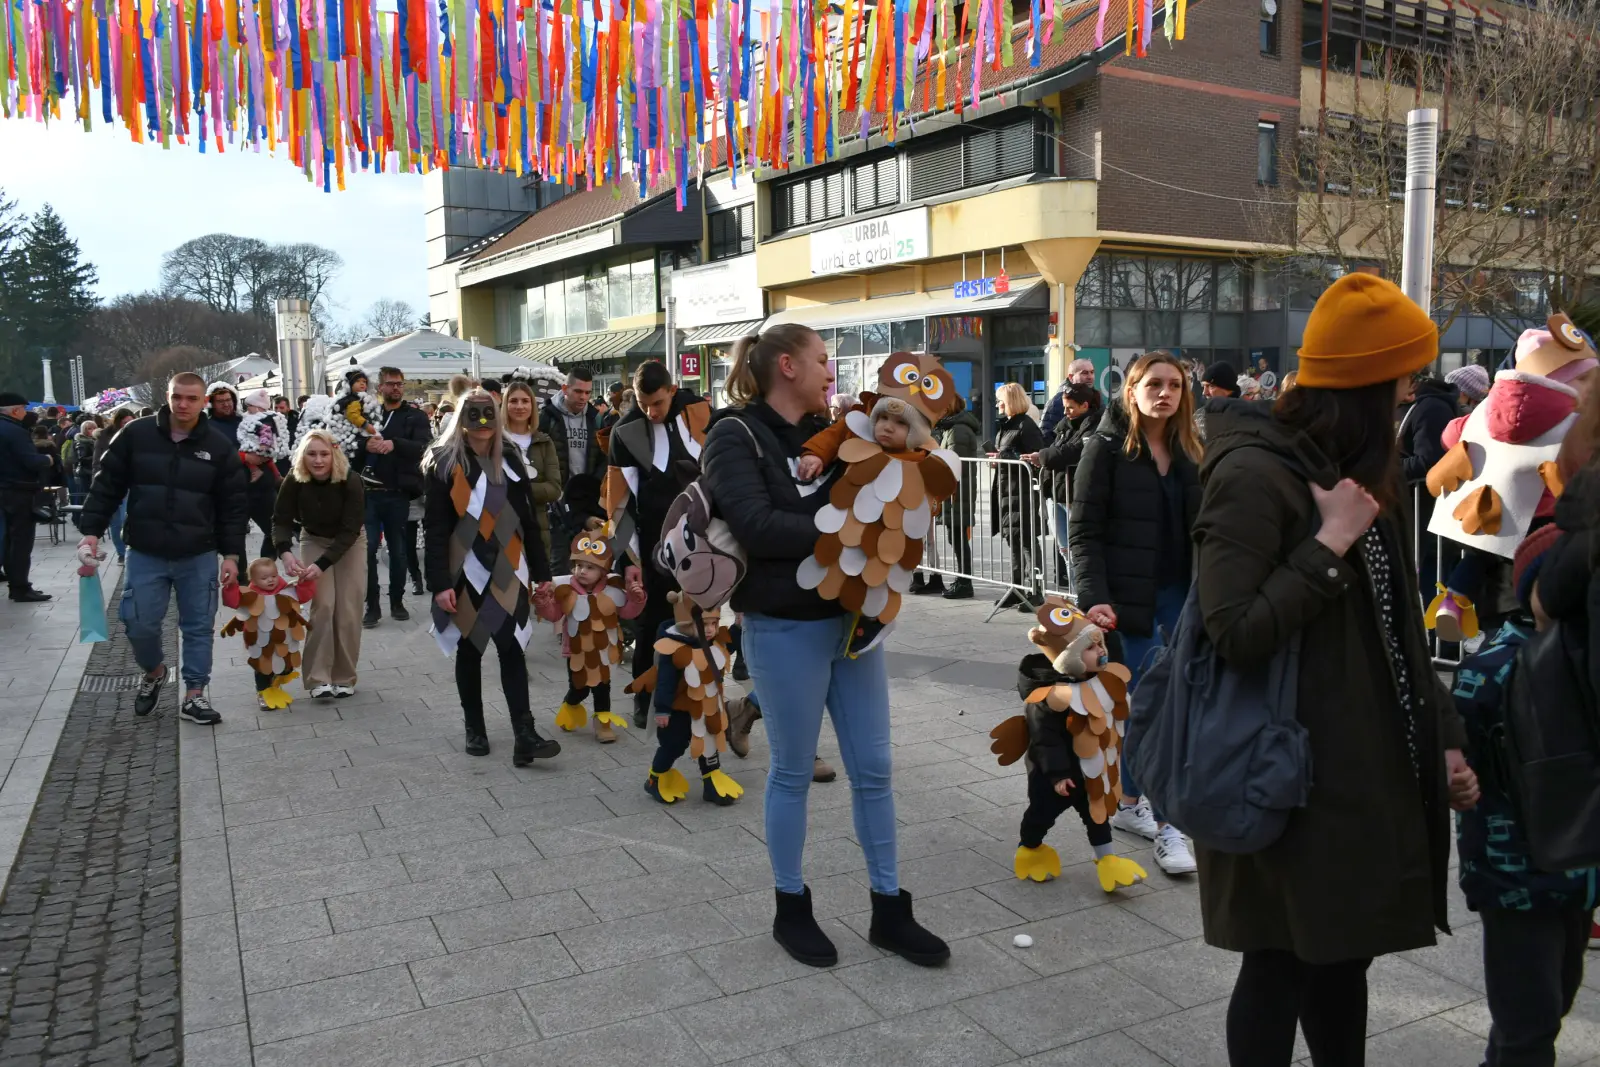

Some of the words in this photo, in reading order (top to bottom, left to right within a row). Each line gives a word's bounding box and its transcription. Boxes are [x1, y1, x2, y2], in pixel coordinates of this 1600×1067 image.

[855, 220, 890, 241] URBIA
[821, 251, 845, 271] urbi
[848, 251, 861, 266] et
[866, 241, 892, 262] orbi
[896, 238, 915, 258] 25
[953, 277, 994, 299] ERSTE
[570, 440, 585, 449] 1991
